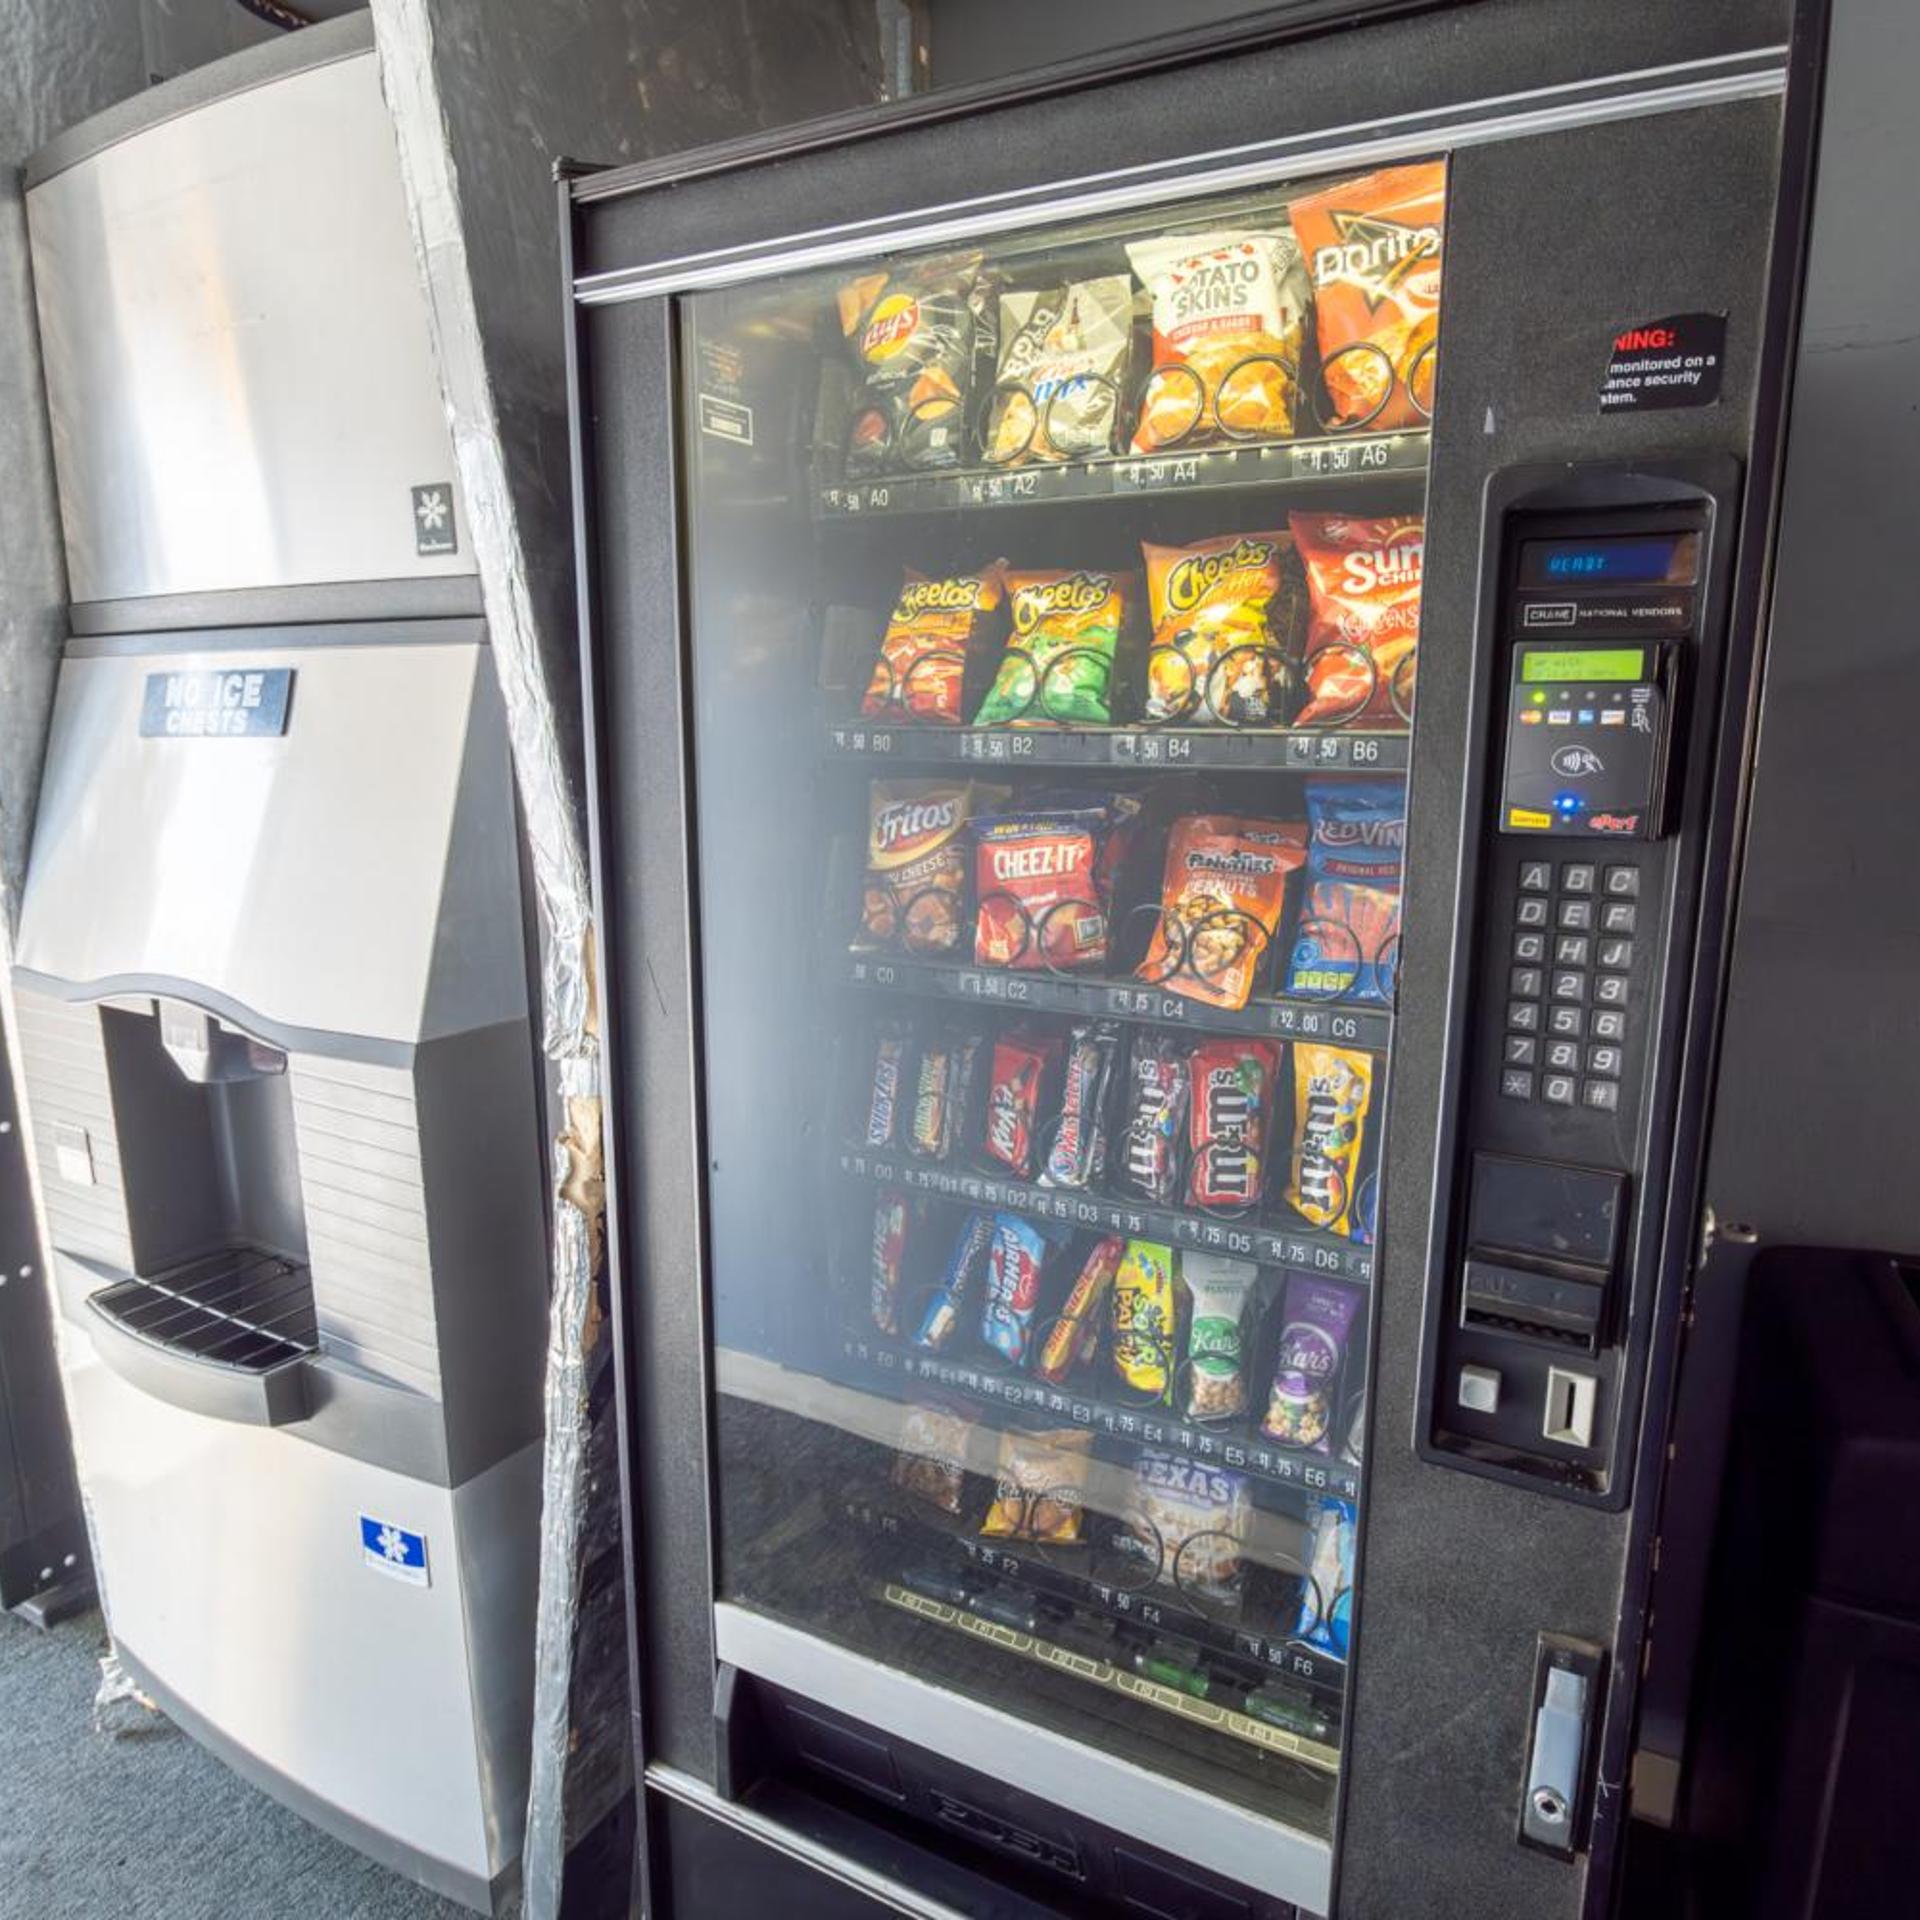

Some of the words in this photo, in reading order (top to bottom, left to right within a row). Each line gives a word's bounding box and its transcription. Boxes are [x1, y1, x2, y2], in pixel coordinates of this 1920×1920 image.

[1190, 260, 1258, 290] TATO
[1175, 284, 1249, 319] SKINS
[1610, 356, 1682, 374] monitored
[1684, 356, 1703, 368] on
[1706, 355, 1716, 366] a
[1604, 377, 1641, 389] ance
[1644, 371, 1702, 386] security
[1361, 445, 1388, 466] A6
[1174, 463, 1196, 481] A4
[1014, 477, 1035, 495] A2
[1168, 540, 1271, 613] Cheetos
[1014, 575, 1107, 636] Ceetos
[1530, 609, 1571, 621] CRANE
[1577, 608, 1628, 618] NATIONAL
[1631, 606, 1683, 617] VENDORS
[164, 676, 200, 708] NO
[213, 673, 265, 708] ICE
[1013, 736, 1033, 754] B2
[1168, 738, 1191, 758] B4
[1353, 740, 1379, 762] B6
[878, 801, 953, 849] Fritos
[1523, 867, 1543, 889] A
[1566, 869, 1588, 890] B
[1609, 871, 1630, 892] C
[1519, 902, 1541, 923] D
[1562, 905, 1584, 926] E
[1605, 907, 1627, 928] F
[1517, 938, 1538, 958] G
[1558, 940, 1582, 961] H
[1603, 944, 1623, 965] J
[1007, 982, 1027, 1000] C2
[1520, 973, 1533, 993] 1
[1556, 976, 1577, 996] 2
[1600, 979, 1621, 1000] 3
[1162, 1000, 1185, 1018] C4
[1512, 1007, 1532, 1026] 4
[1331, 1018, 1357, 1038] C6
[1554, 1011, 1574, 1030] 5
[1597, 1015, 1617, 1035] 6
[1512, 1039, 1529, 1060] 7
[1550, 1045, 1570, 1065] 8
[1593, 1050, 1612, 1070] 9
[1547, 1079, 1567, 1099] 0
[1007, 1190, 1027, 1207] D2
[1078, 1204, 1098, 1222] D3
[1228, 1233, 1251, 1252] D5
[1315, 1248, 1339, 1269] D6
[1005, 1386, 1023, 1404] E2
[1072, 1404, 1091, 1422] E3
[1143, 1424, 1162, 1443] E4
[1225, 1447, 1244, 1466] E5
[1137, 1460, 1230, 1503] TEXAS
[1305, 1468, 1326, 1488] E6
[1003, 1559, 1019, 1576] F2
[1143, 1606, 1160, 1625] F4
[1293, 1656, 1313, 1676] F6
